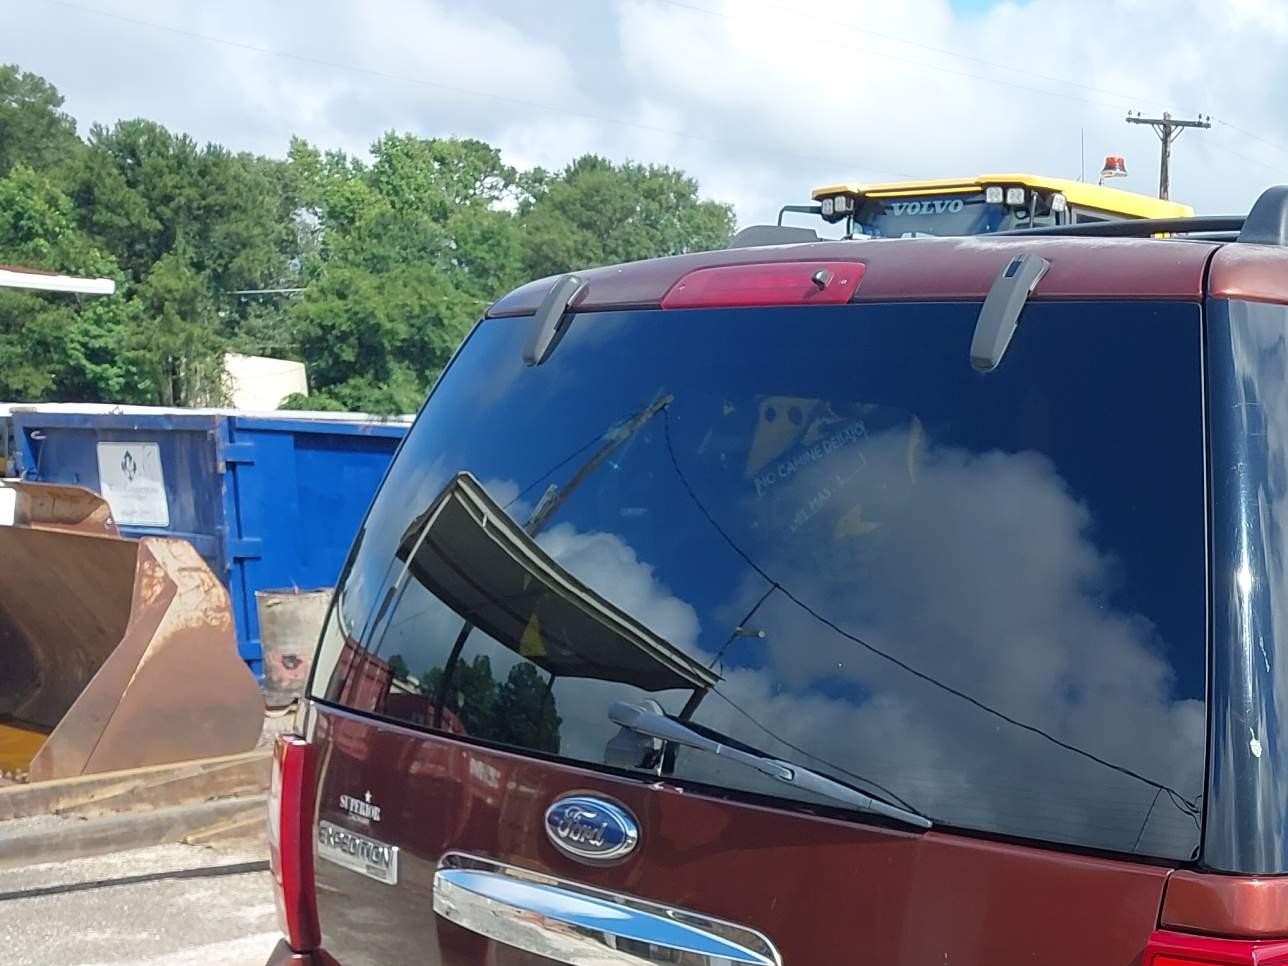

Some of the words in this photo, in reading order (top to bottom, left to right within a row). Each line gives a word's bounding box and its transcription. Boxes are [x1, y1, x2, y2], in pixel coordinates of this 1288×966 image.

[890, 199, 964, 217] VOLVO
[339, 794, 382, 821] SUPERIOR
[556, 806, 609, 848] Ford
[319, 826, 394, 870] EXPEDITION
